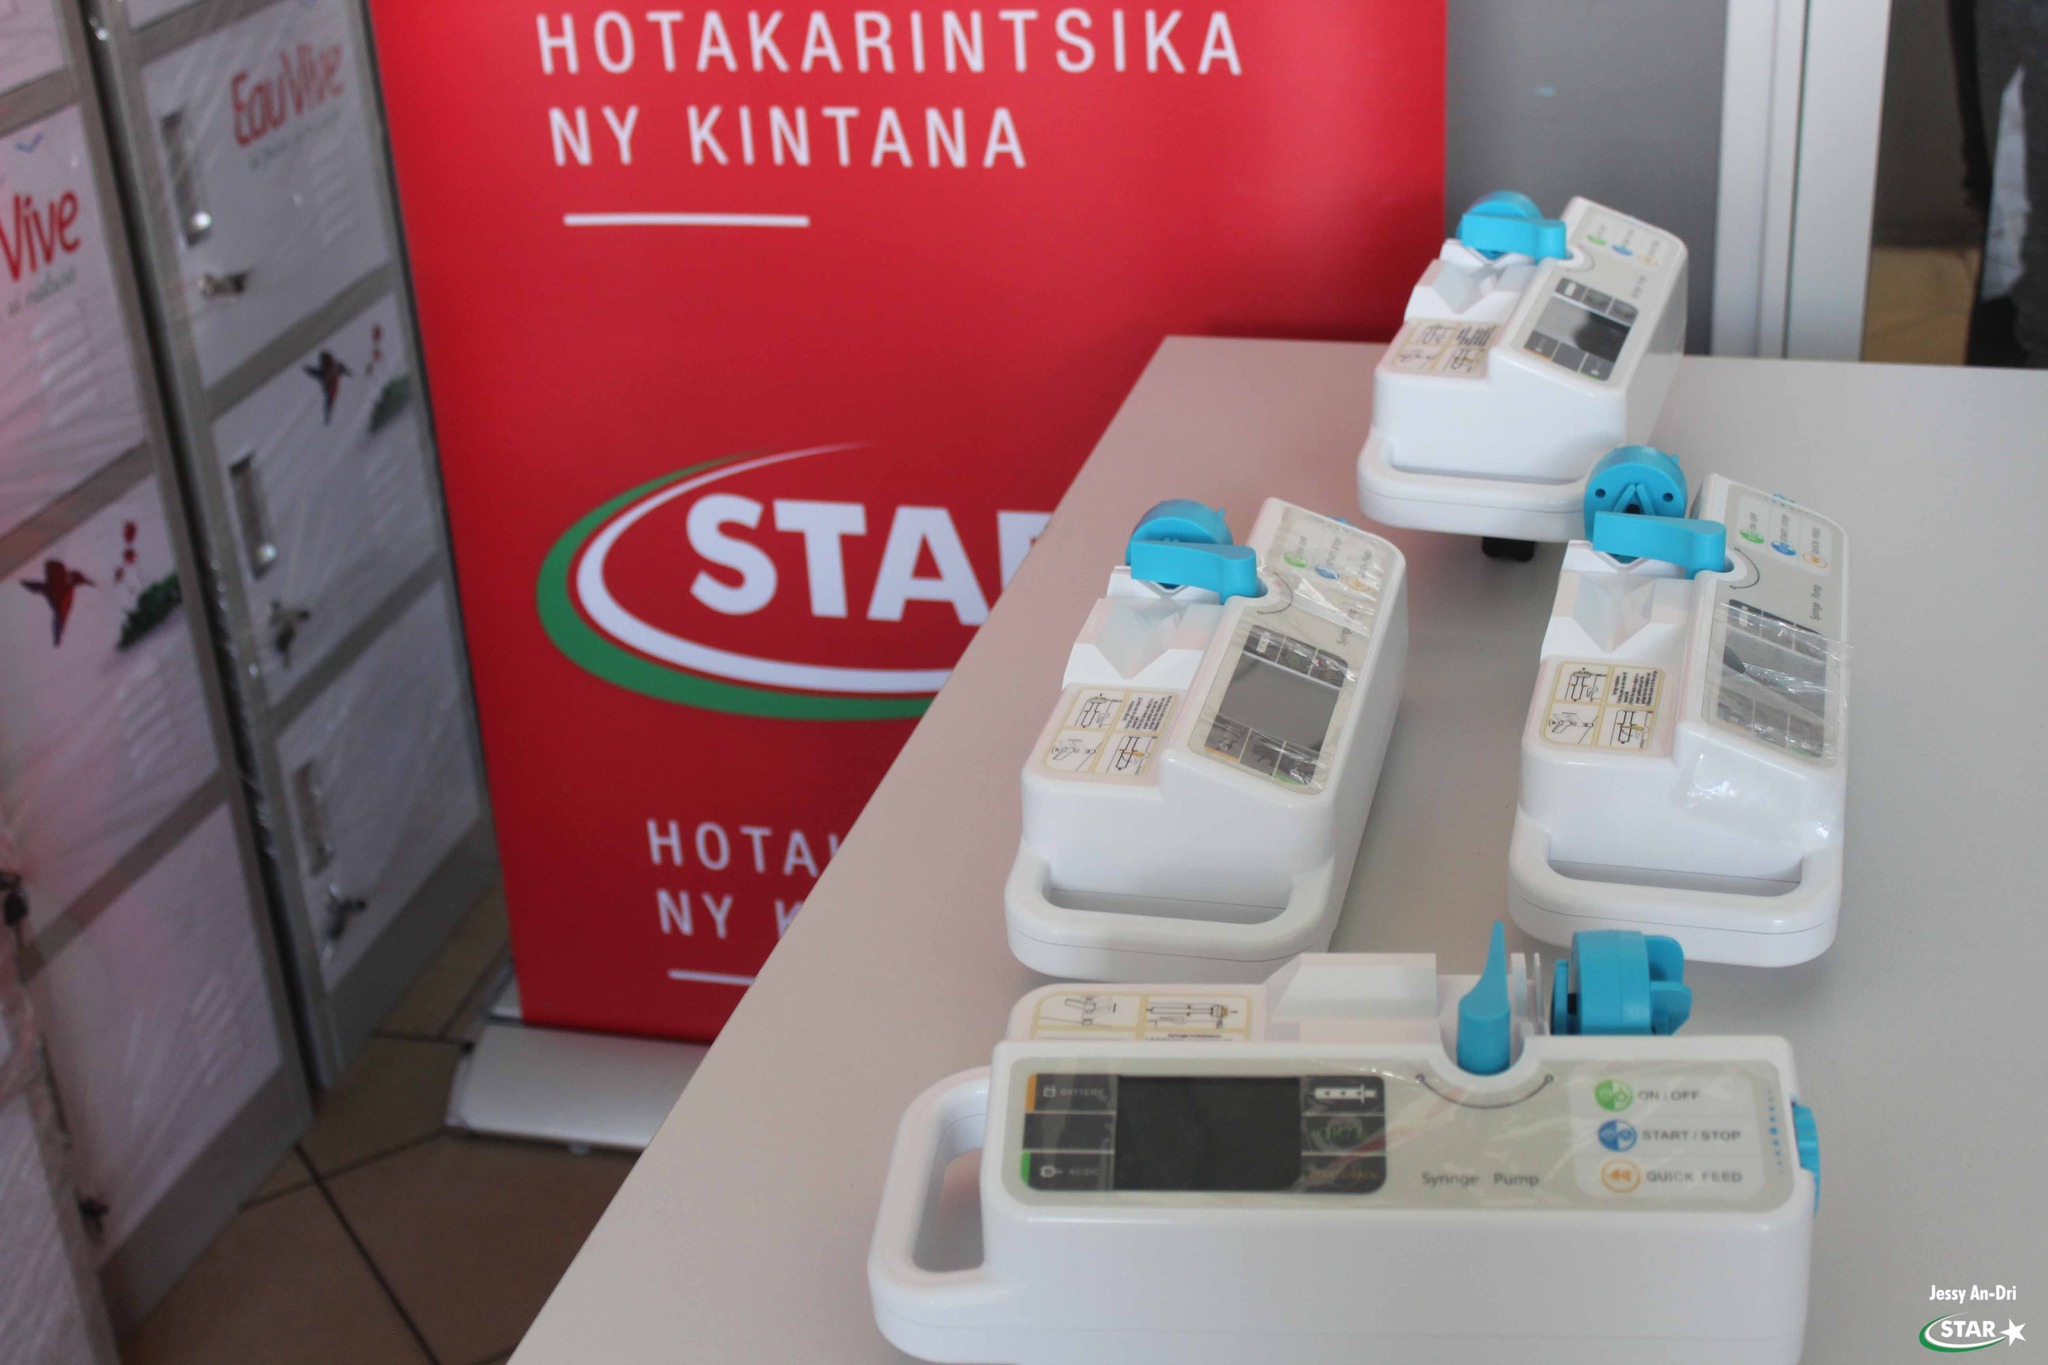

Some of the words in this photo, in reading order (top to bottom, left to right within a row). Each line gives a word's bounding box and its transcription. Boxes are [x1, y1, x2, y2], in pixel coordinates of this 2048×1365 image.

[536, 8, 1242, 75] HOTAKARINTSIKA
[549, 105, 639, 166] NY
[687, 105, 1026, 168] KINTANA
[656, 888, 734, 939] NY
[1642, 1130, 1690, 1141] START
[1701, 1130, 1741, 1141] STOP
[1421, 1172, 1479, 1189] Syringe
[1493, 1172, 1539, 1187] Pump
[1646, 1171, 1694, 1183] QUICK
[1702, 1171, 1743, 1183] FEED
